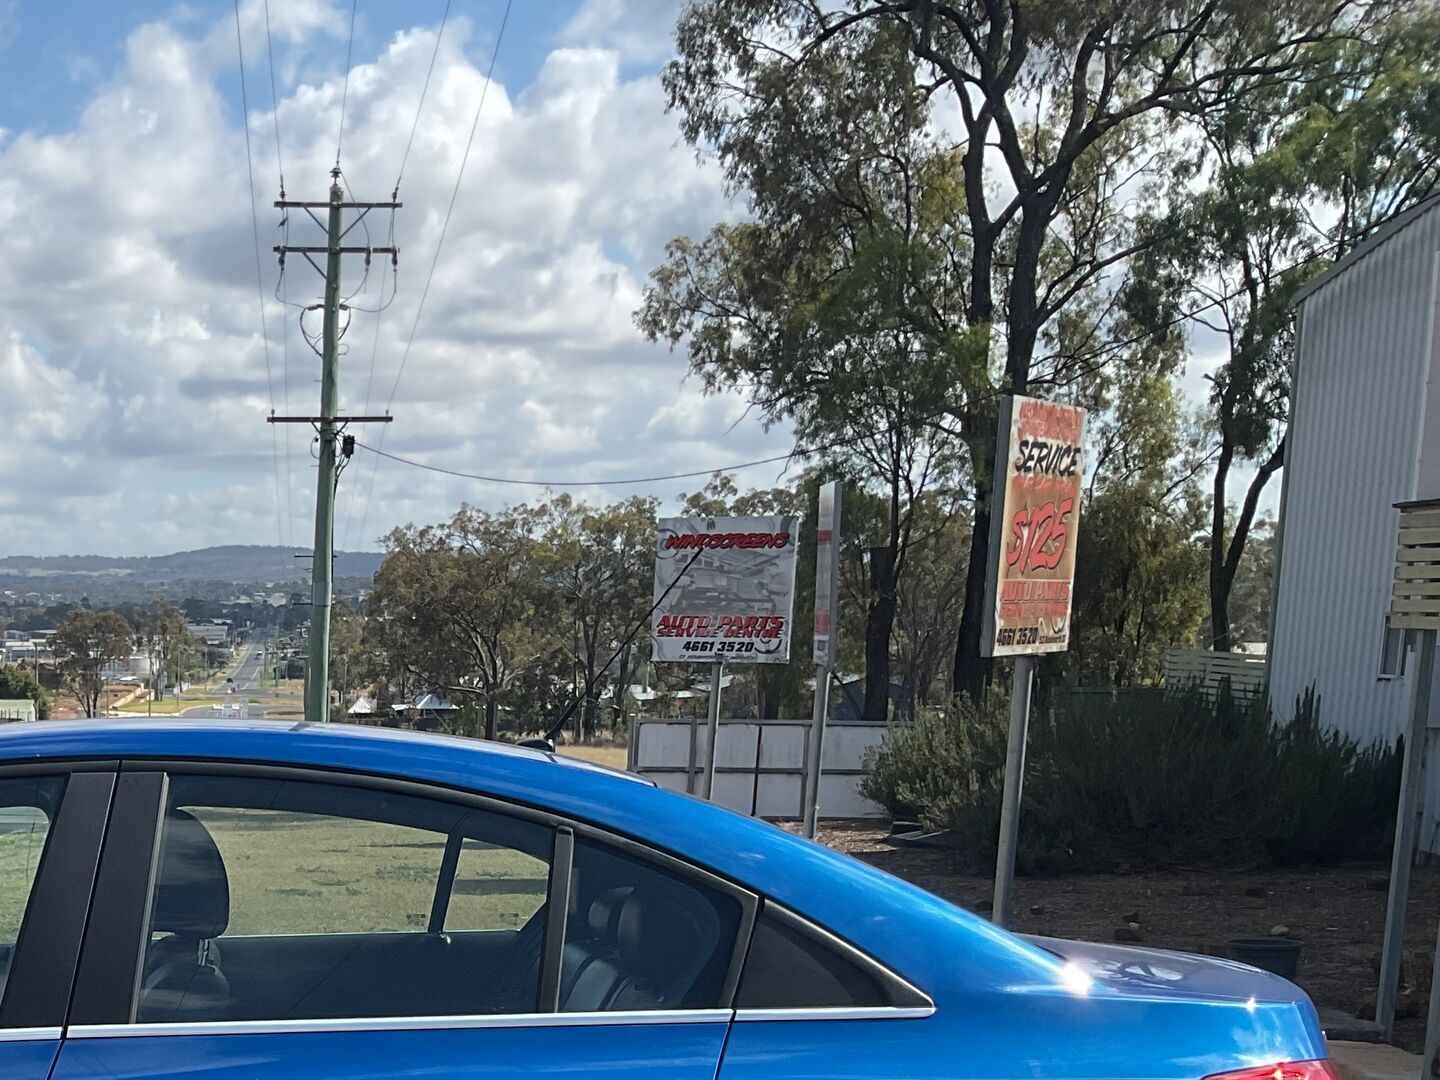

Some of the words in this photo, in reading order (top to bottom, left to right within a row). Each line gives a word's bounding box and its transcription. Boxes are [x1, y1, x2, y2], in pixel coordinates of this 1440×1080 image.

[1015, 440, 1081, 477] SERVICE
[665, 533, 790, 549] WINDSCREENS
[657, 615, 711, 629] AUTO
[718, 616, 785, 630] PARTS
[657, 627, 720, 638] SERVICE
[723, 628, 784, 639] CENTRE
[997, 628, 1016, 647] 4661
[1016, 626, 1038, 645] 3520
[682, 641, 715, 652] 4661
[717, 641, 755, 653] 3520
